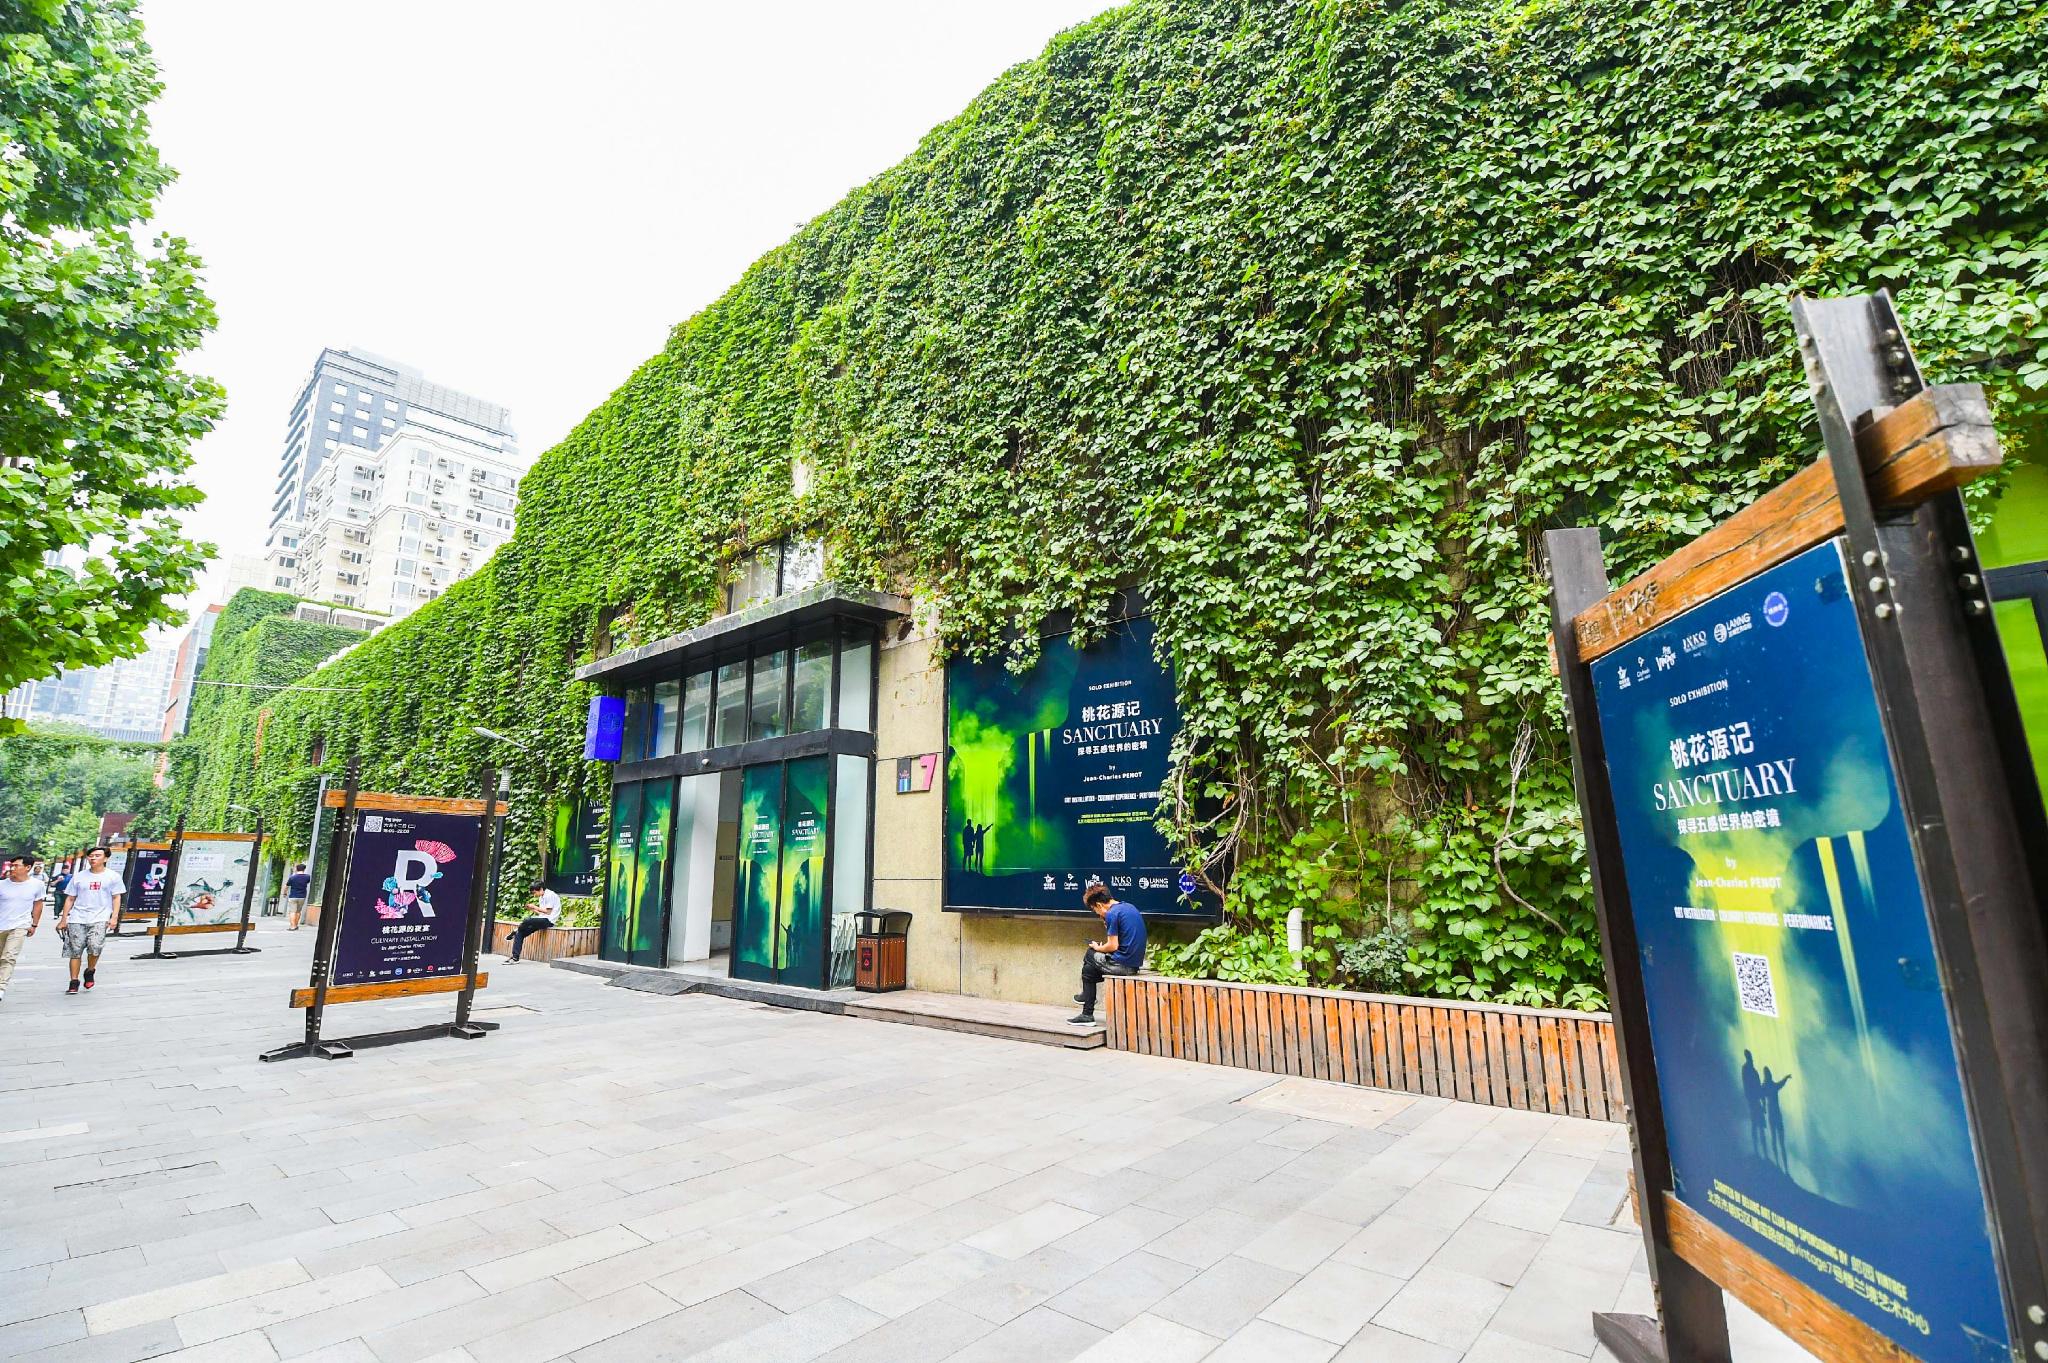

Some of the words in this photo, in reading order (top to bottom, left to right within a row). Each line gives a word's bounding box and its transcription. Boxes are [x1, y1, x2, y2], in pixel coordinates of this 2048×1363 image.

[1103, 680, 1132, 690] EXHIBITION
[1669, 694, 1687, 707] SOLO
[1688, 678, 1729, 701] EXHIBITION
[1082, 701, 1140, 723] 桃花源记
[1062, 718, 1163, 745] SANCTUARY
[1670, 722, 1754, 769] 桃花源记
[919, 754, 937, 791] 7
[1083, 774, 1121, 782] Jean-Charles
[1122, 771, 1143, 779] PENOT
[1653, 758, 1798, 811] SANCTUARY
[791, 827, 820, 836] SANCTUARY
[1678, 808, 1782, 835] 探寻五感世界的密境
[1725, 856, 1736, 869] by
[393, 849, 438, 918] R
[1696, 876, 1748, 888] Jean-Charles
[1750, 876, 1783, 889] PENOT
[1783, 913, 1835, 931] PERFORMANCE
[370, 937, 399, 945] CULINARY
[400, 935, 438, 943] INSTALLATION
[1875, 1269, 1909, 1301] VINTAGE
